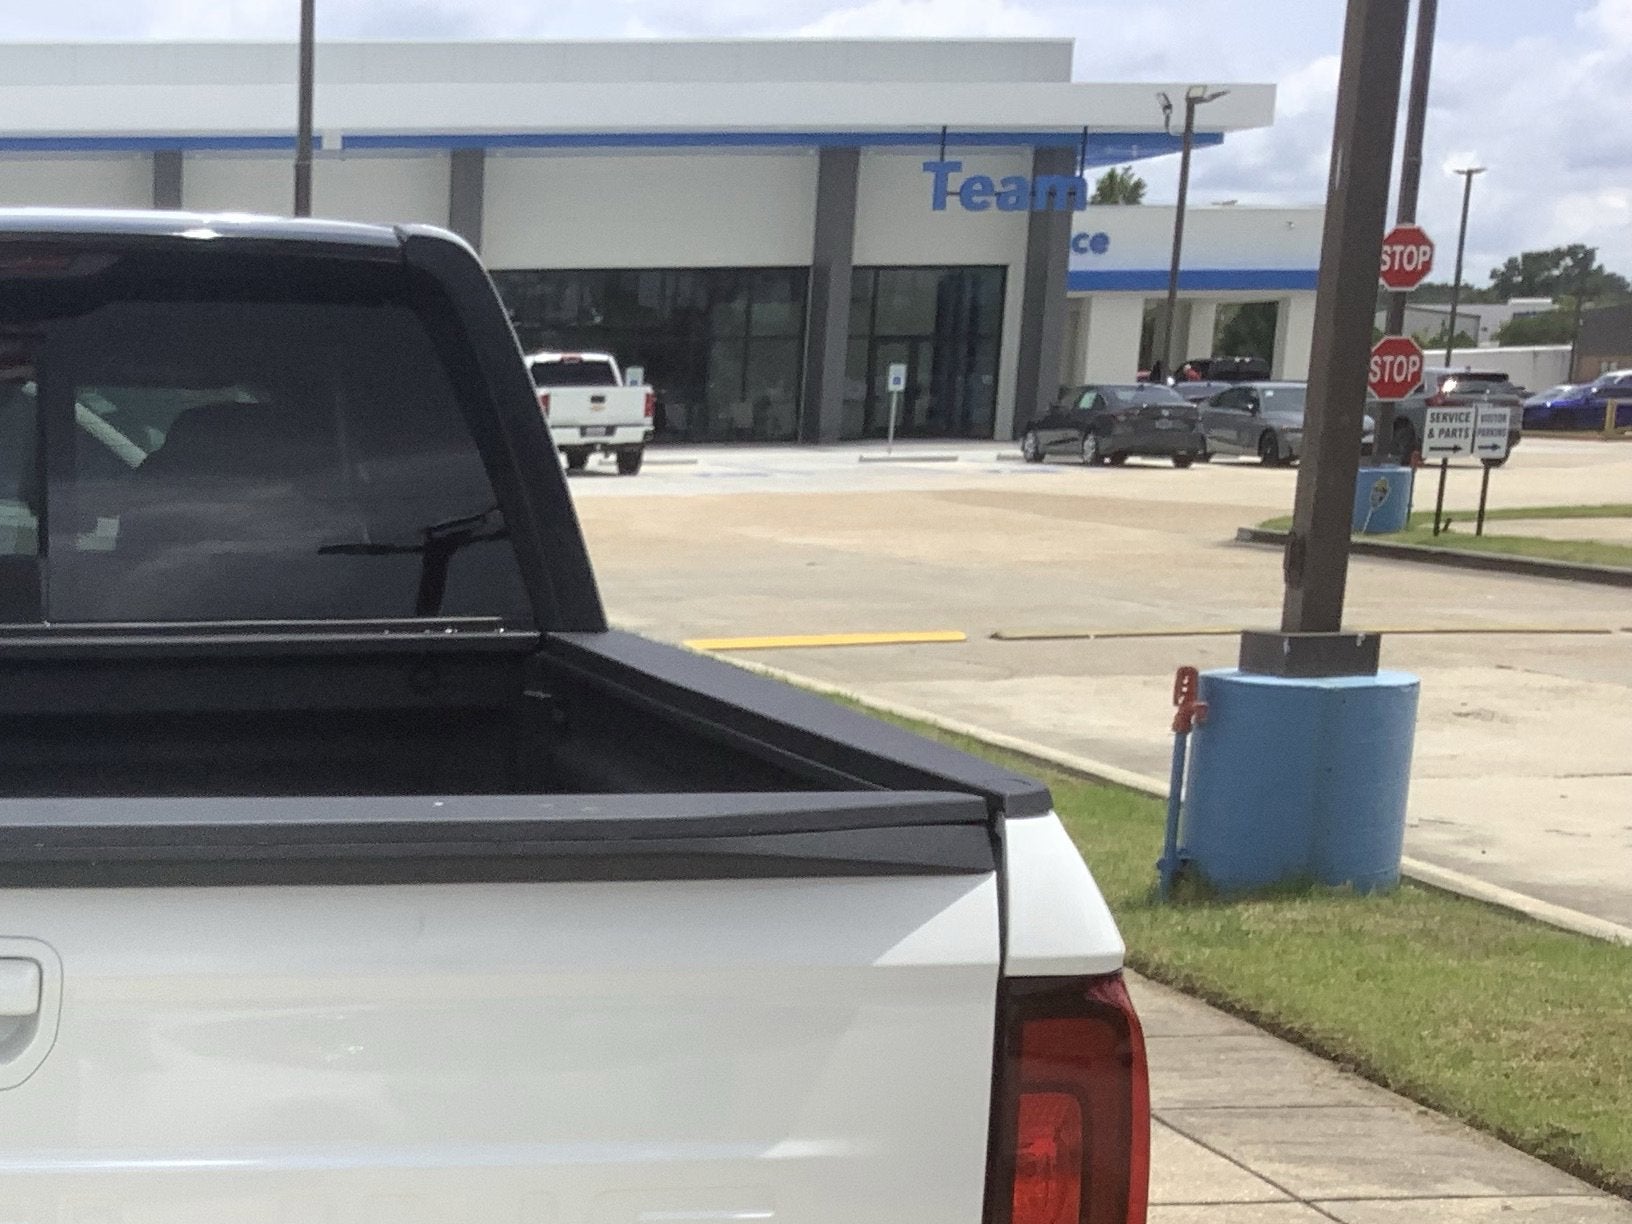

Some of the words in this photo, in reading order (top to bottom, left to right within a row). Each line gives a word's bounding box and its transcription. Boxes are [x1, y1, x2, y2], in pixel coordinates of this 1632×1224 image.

[923, 160, 1088, 212] Team
[1380, 244, 1431, 272] STOP
[1369, 354, 1420, 384] STOP
[1429, 411, 1471, 423] SERVICE
[1438, 427, 1470, 439] PARTS
